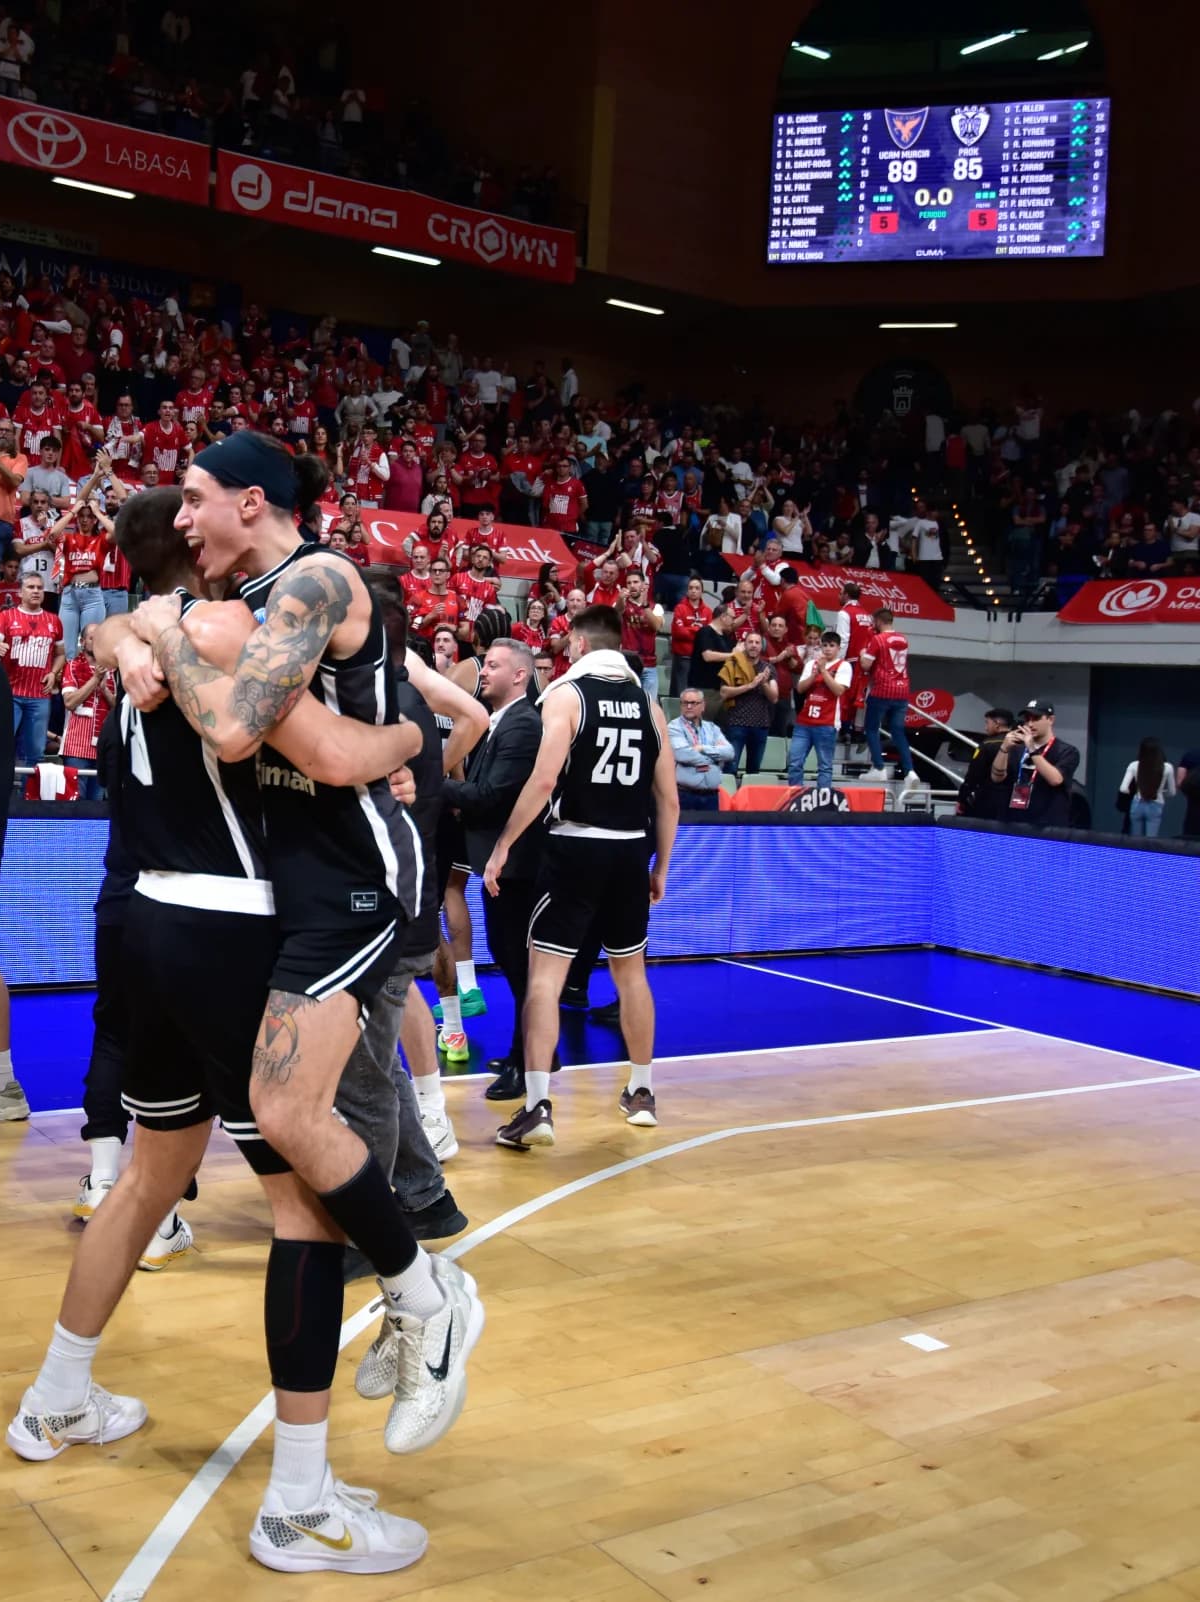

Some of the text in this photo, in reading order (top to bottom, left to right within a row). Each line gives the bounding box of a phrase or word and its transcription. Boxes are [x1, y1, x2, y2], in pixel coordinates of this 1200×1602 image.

[104, 143, 193, 181] LABASA
[879, 151, 900, 160] UCAM
[888, 160, 917, 183] 89
[953, 157, 983, 180] 85
[283, 179, 398, 230] dama
[915, 189, 953, 206] 0.0
[880, 216, 888, 229] 5
[928, 219, 936, 231] 4
[978, 213, 987, 226] 5
[35, 558, 48, 571] 13
[882, 599, 920, 614] Murcia
[597, 700, 641, 720] FILLIOS
[808, 705, 822, 719] 15
[591, 727, 642, 786] 25
